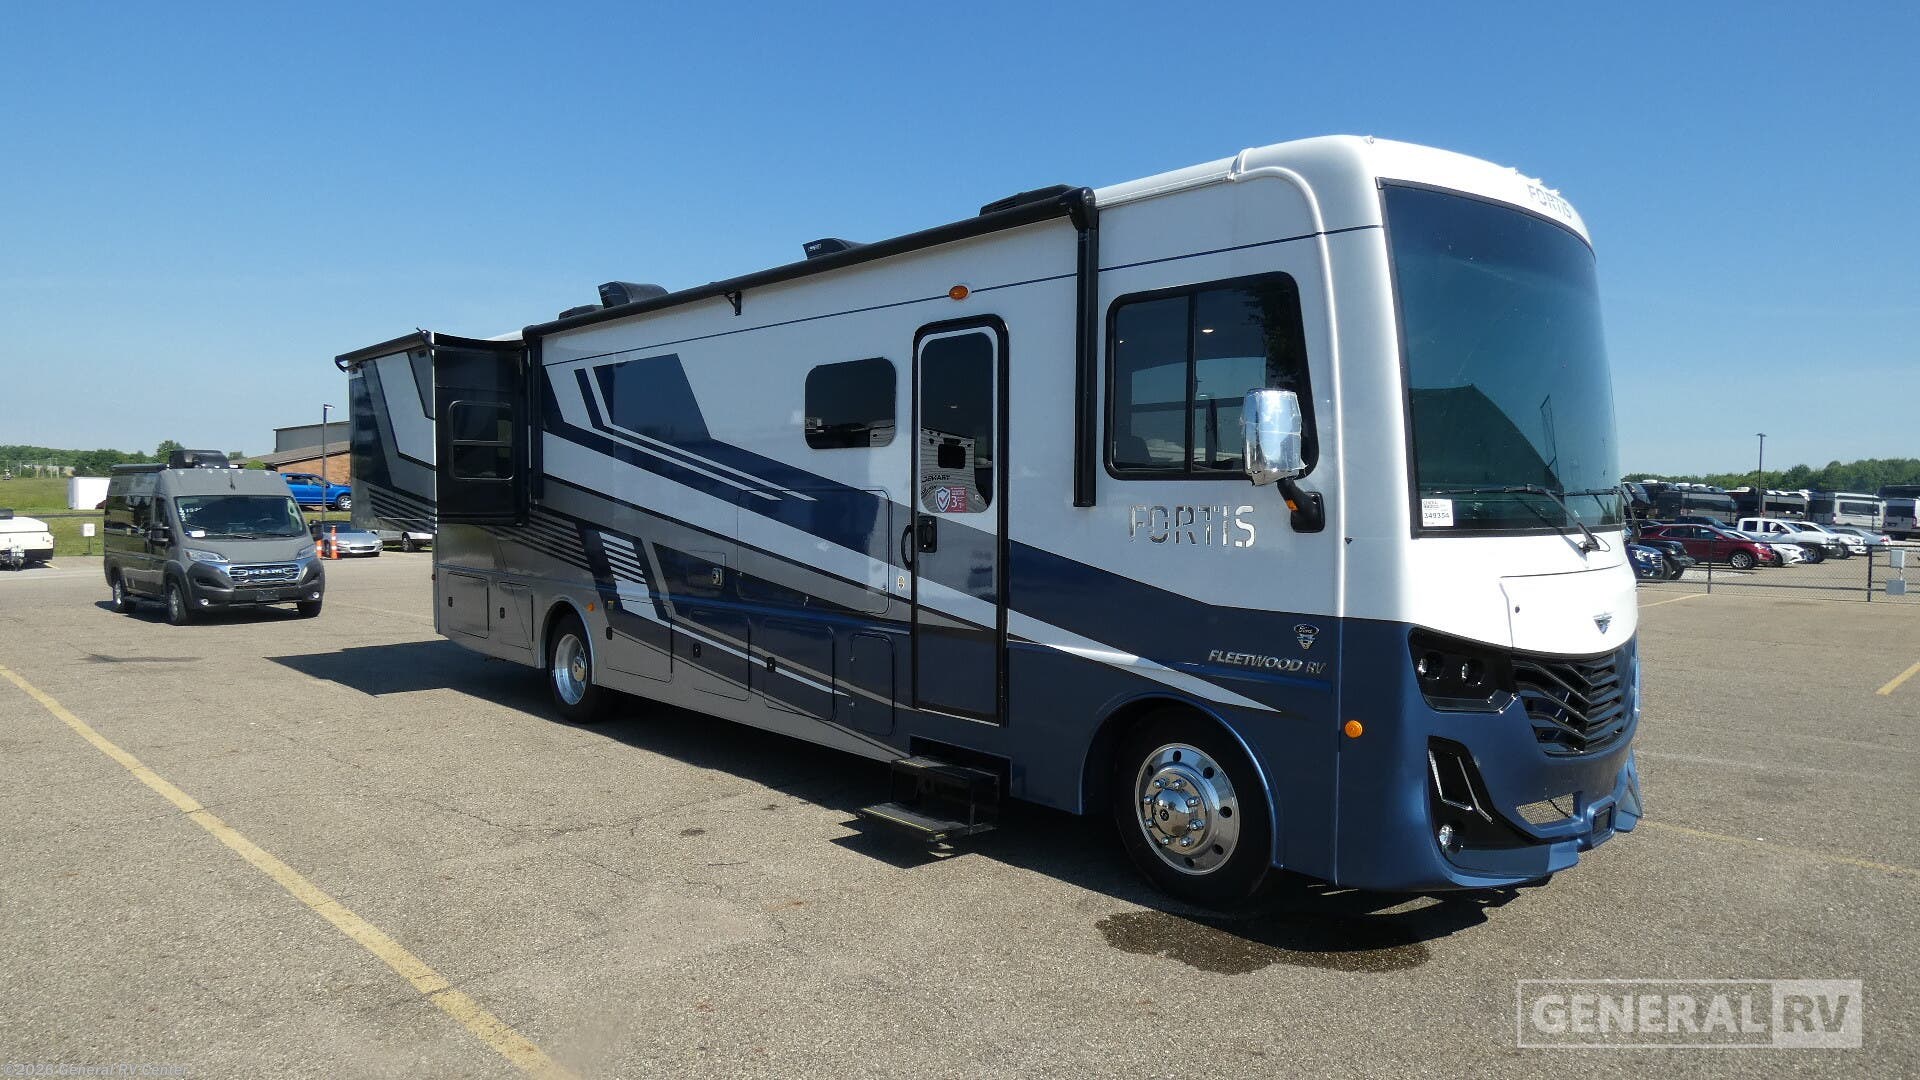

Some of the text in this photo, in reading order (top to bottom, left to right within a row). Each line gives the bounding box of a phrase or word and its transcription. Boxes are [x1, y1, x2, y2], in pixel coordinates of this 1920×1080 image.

[1527, 184, 1572, 219] FORTIS
[1129, 505, 1256, 548] FORTIS
[1208, 649, 1328, 674] FLEETWOOD RV
